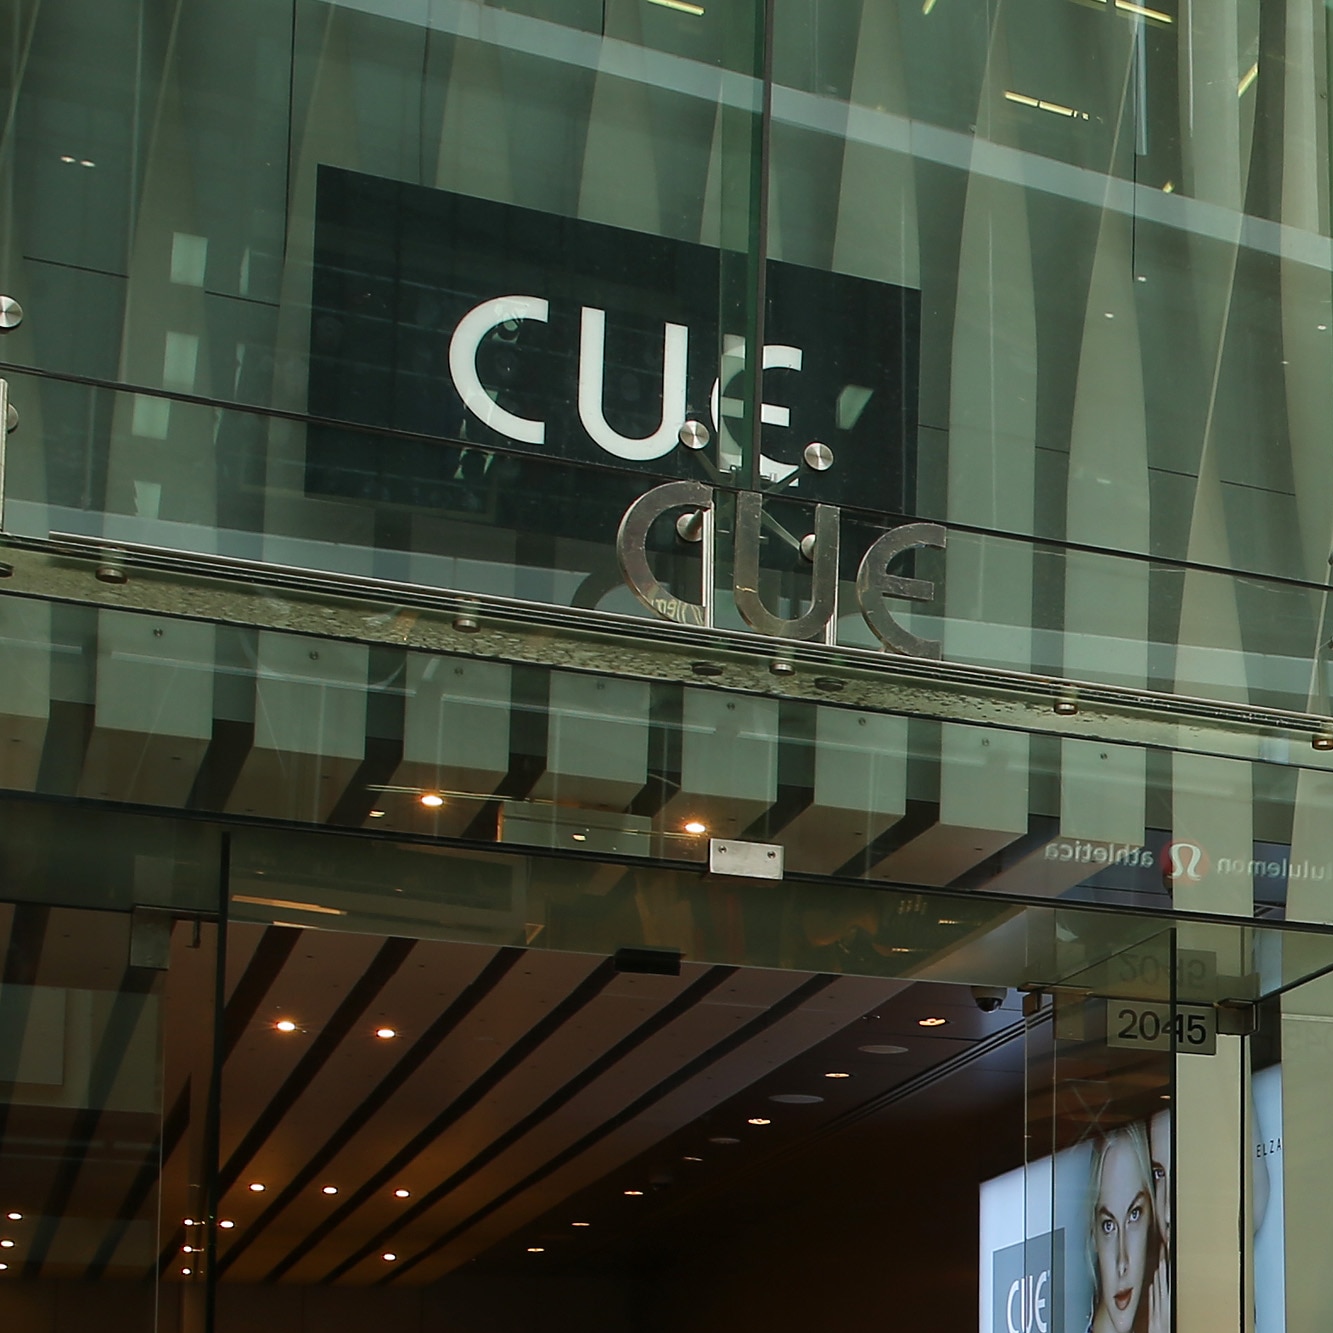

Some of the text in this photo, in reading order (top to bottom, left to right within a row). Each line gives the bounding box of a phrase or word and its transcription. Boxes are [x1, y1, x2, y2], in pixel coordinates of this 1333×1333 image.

[449, 294, 804, 488] CUE
[617, 480, 948, 660] CUE
[1117, 1008, 1207, 1045] 2045
